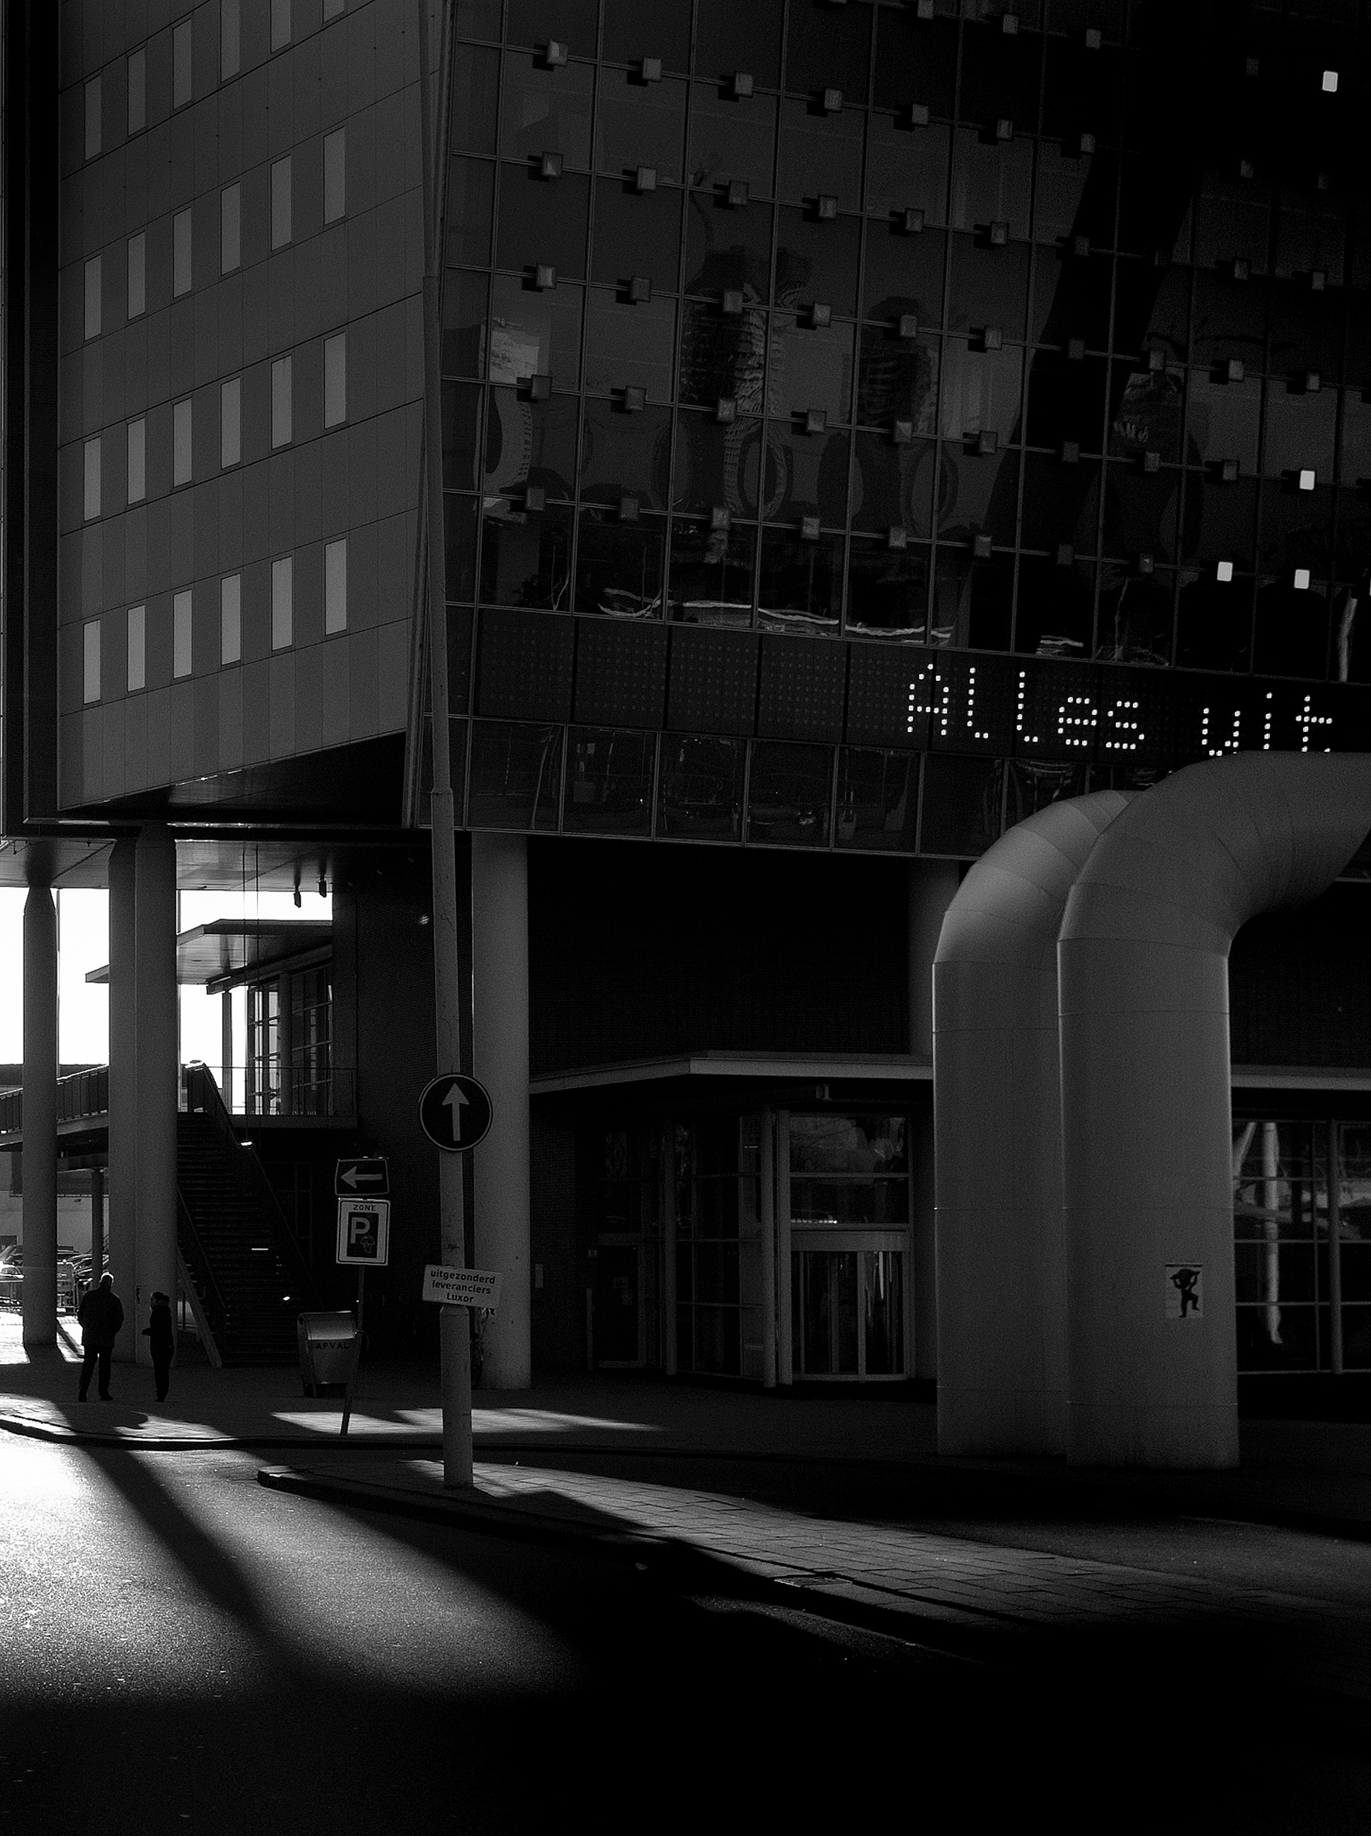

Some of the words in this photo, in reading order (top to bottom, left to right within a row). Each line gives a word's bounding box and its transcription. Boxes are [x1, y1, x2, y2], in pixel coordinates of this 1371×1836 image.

[1201, 692, 1333, 756] uit
[353, 1203, 377, 1212] ZONE
[350, 1216, 371, 1244] P
[430, 1269, 496, 1285] uitgezonderd
[432, 1280, 492, 1295] leveranciers
[446, 1292, 475, 1303] Luxor
